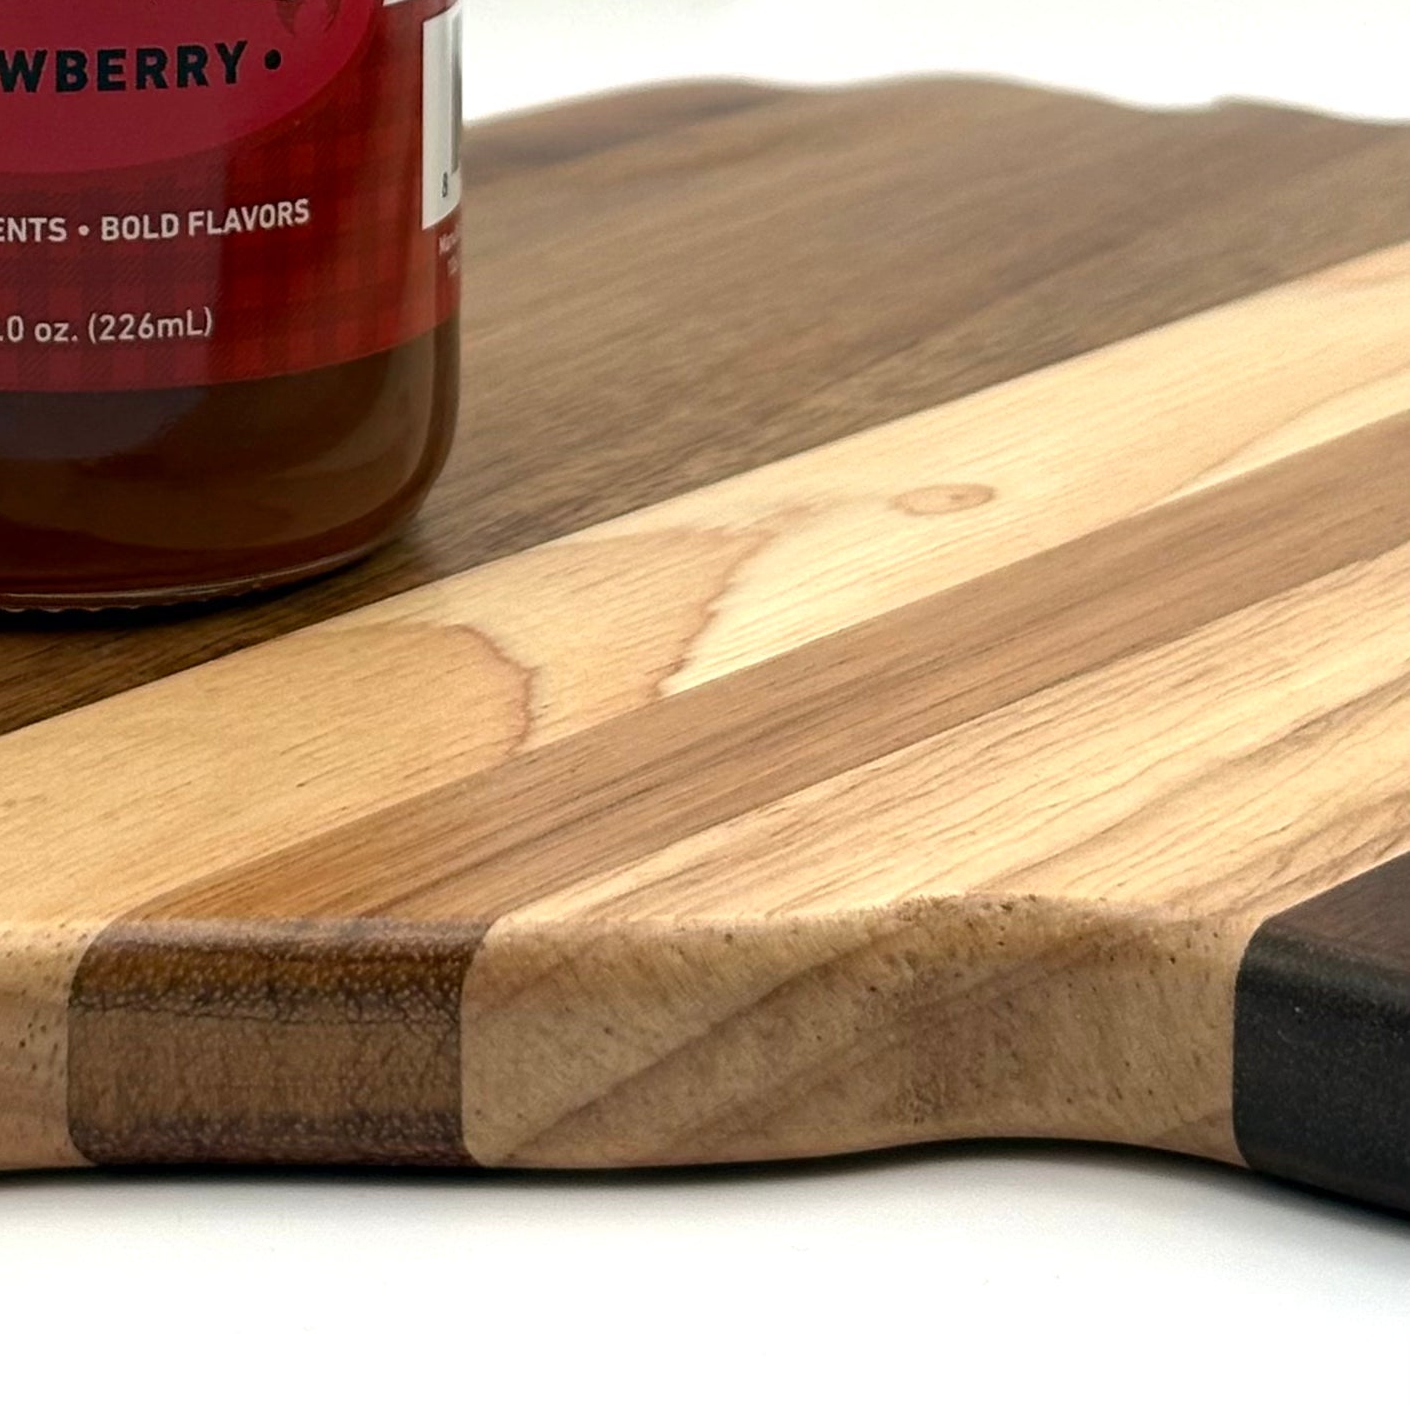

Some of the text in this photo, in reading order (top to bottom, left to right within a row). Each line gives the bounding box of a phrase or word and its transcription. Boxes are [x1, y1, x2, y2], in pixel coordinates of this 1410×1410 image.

[100, 213, 181, 242] BOLD
[188, 197, 312, 237] FLAVORS
[33, 319, 79, 344] oz.
[88, 305, 215, 346] (226mL)
